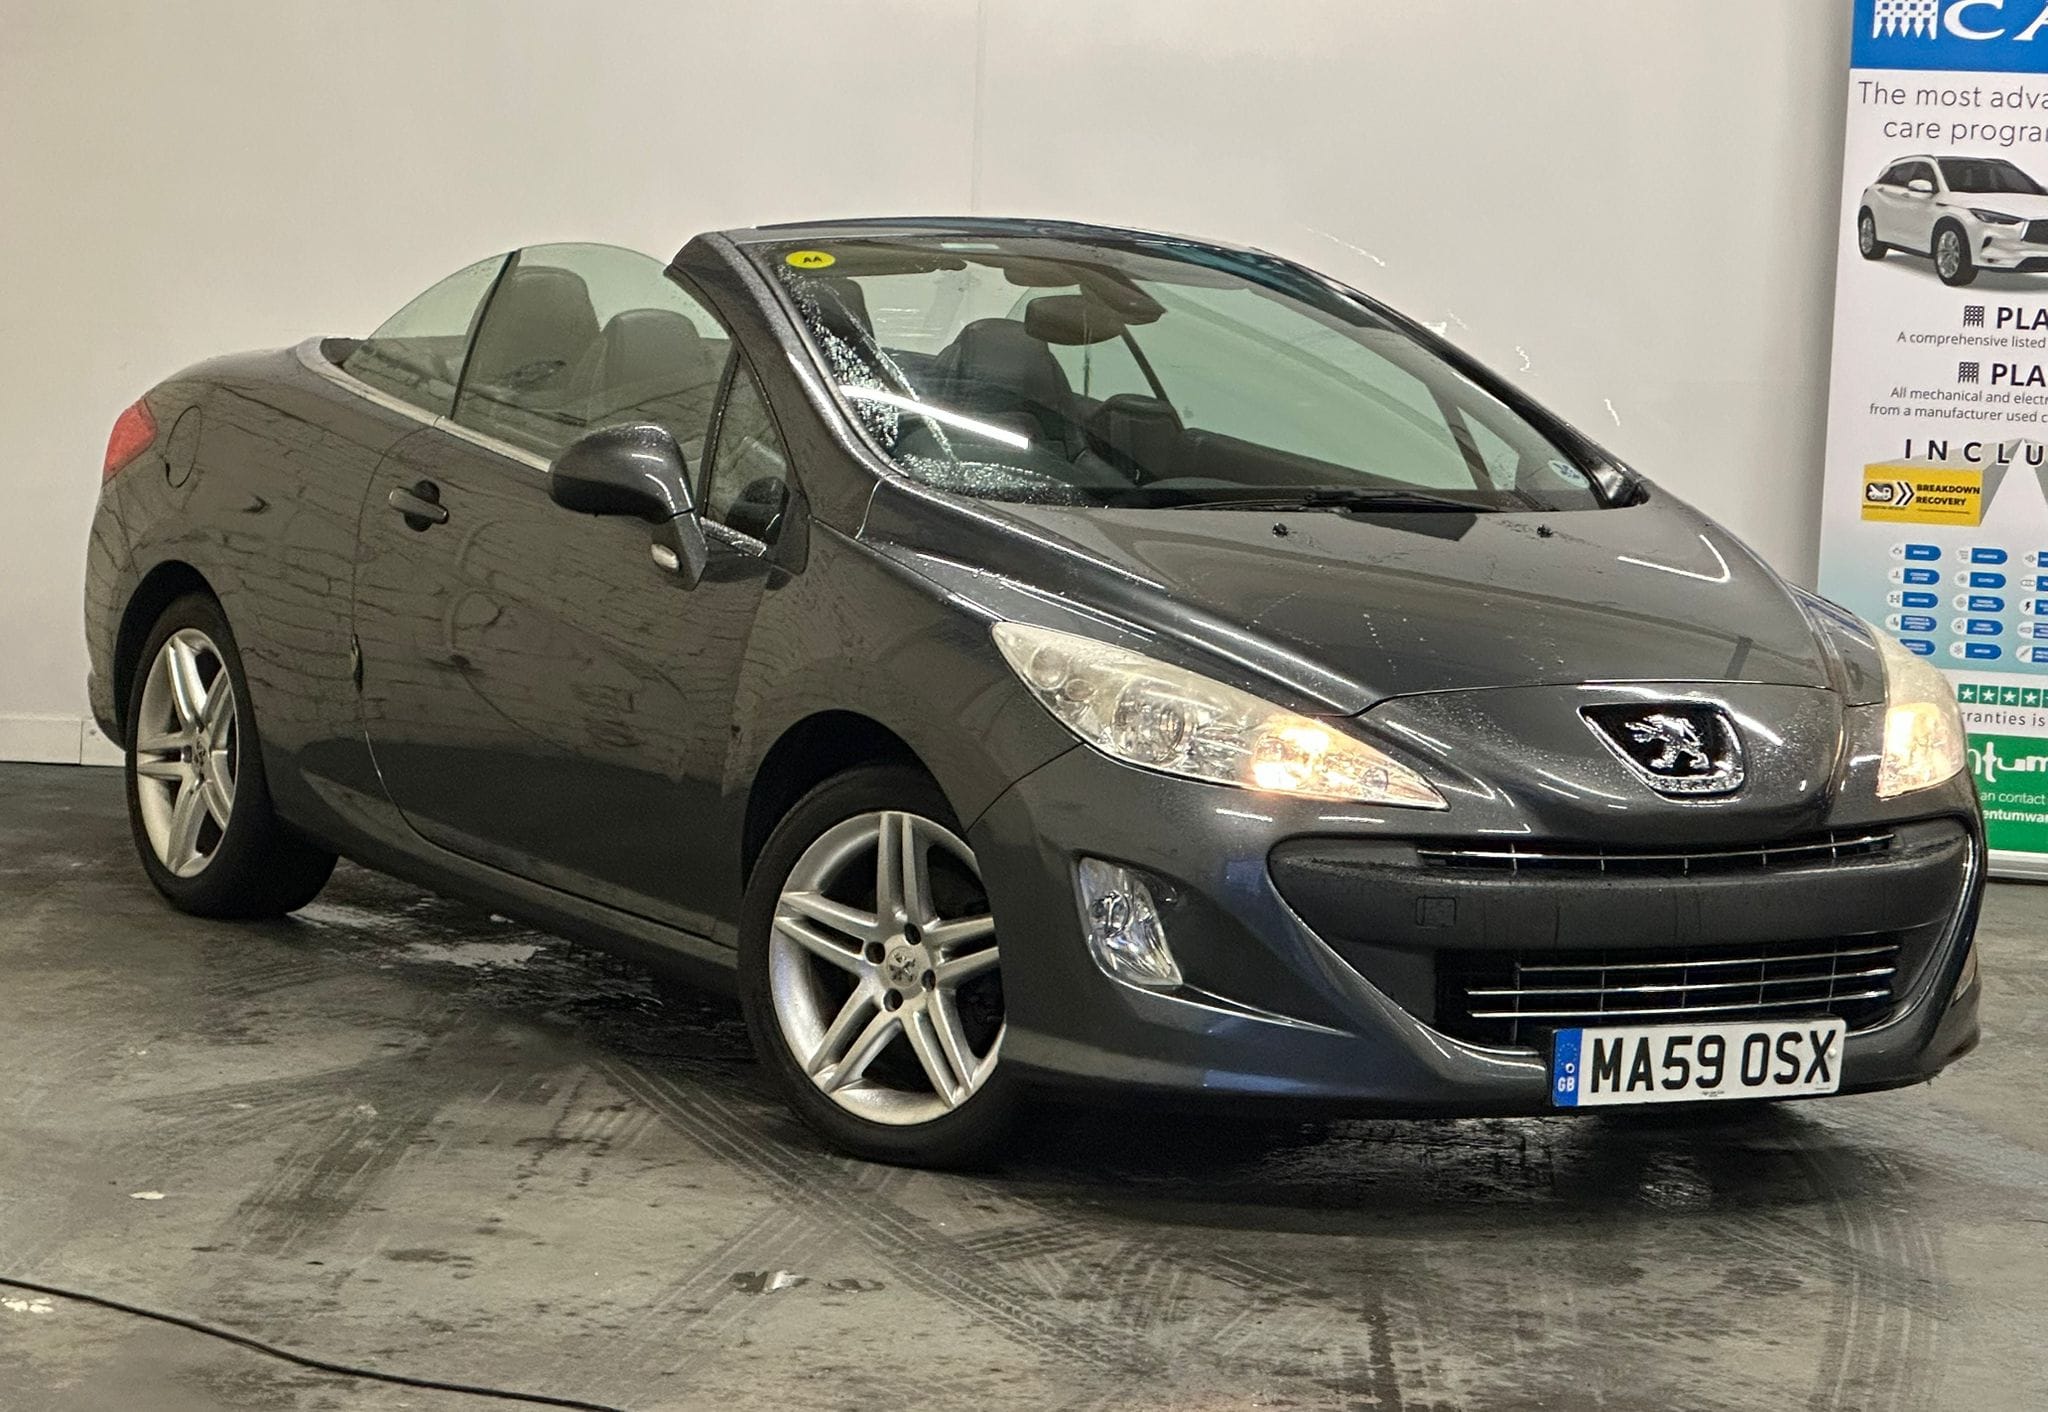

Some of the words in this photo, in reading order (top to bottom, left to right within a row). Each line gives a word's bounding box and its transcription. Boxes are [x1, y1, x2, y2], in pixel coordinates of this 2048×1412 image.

[1858, 81, 1906, 105] The
[1916, 87, 1981, 107] most
[1883, 120, 1941, 138] care
[1950, 124, 2048, 147] progra
[1996, 307, 2048, 331] PLA
[1897, 331, 1906, 343] A
[1909, 332, 2008, 347] comprehensive
[2011, 335, 2046, 348] listed
[1991, 363, 2046, 387] PLA
[1890, 386, 1906, 398] All
[1909, 387, 1982, 402] mechanical
[1985, 391, 2010, 404] and
[1869, 402, 1900, 417] from
[1903, 407, 1911, 417] a
[1914, 405, 2002, 422] manufacturer
[2006, 411, 2038, 422] used
[1904, 438, 2043, 466] INCLU
[1916, 483, 1980, 495] BREAKDOWN
[1915, 496, 1967, 506] RECOVERY
[2032, 713, 2046, 727] is
[1998, 792, 2046, 806] contact
[1590, 1034, 1727, 1094] MA59
[1740, 1029, 1837, 1087] OSX
[1557, 1077, 1575, 1093] GB
